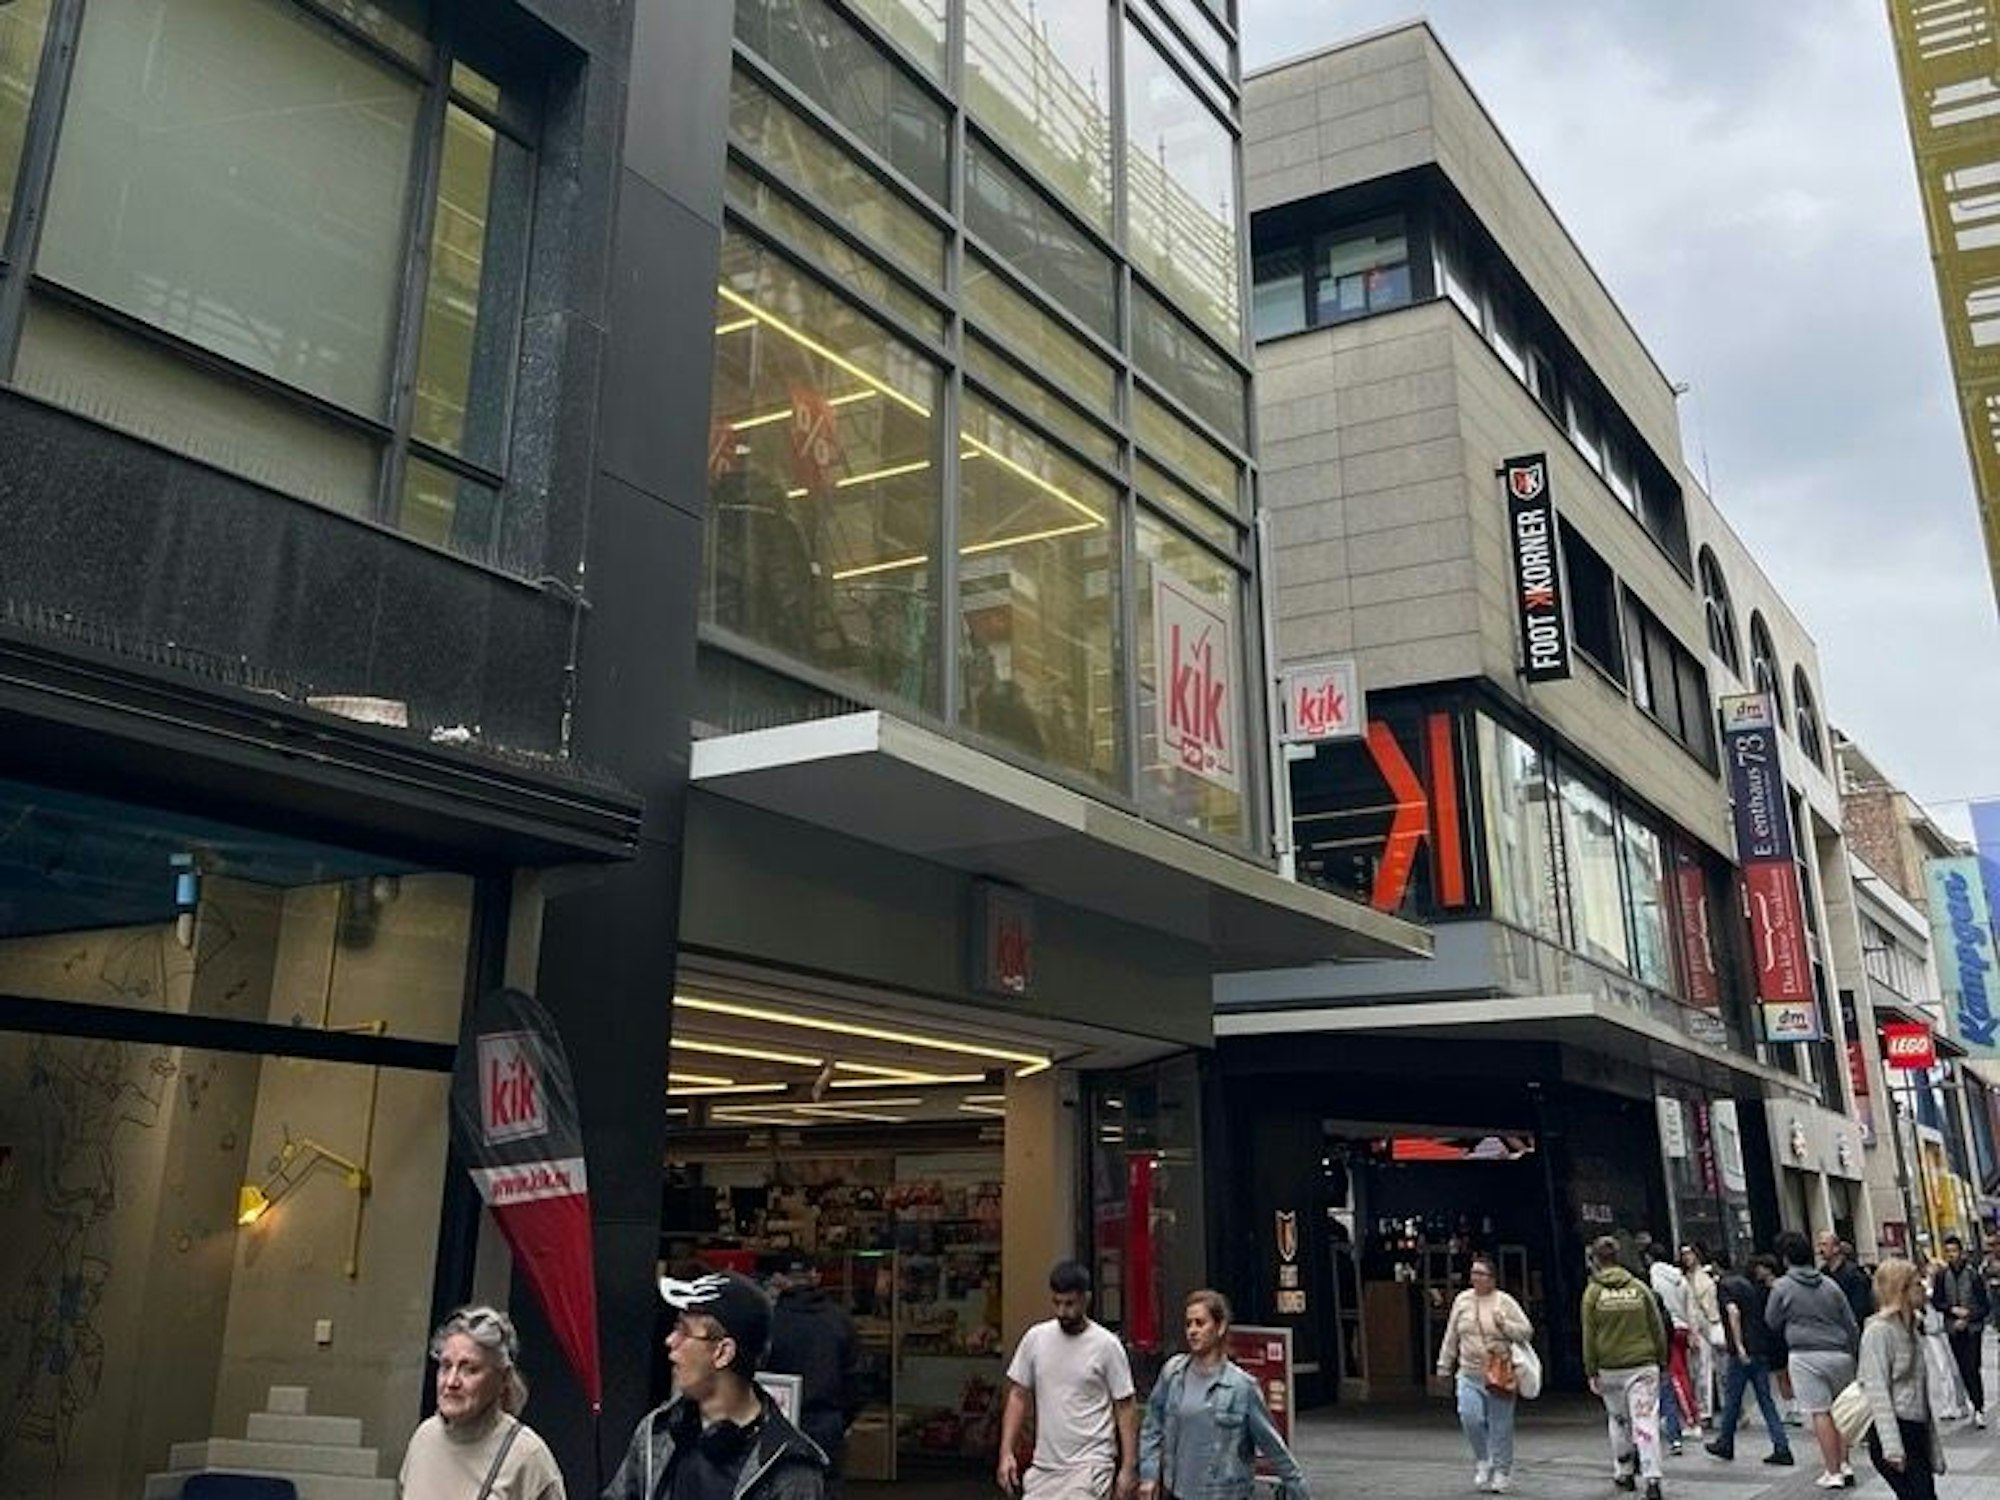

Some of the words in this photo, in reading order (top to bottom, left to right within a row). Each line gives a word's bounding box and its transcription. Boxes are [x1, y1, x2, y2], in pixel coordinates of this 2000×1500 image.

[1517, 508, 1553, 594] KORNER
[1527, 614, 1561, 669] FOOT
[1169, 624, 1224, 750] kik
[1299, 679, 1343, 727] kik
[1736, 701, 1761, 715] dm
[1747, 767, 1773, 856] Eenthaus
[1778, 1009, 1805, 1024] dm
[1889, 1036, 1929, 1054] LEGO
[491, 1053, 537, 1128] kik
